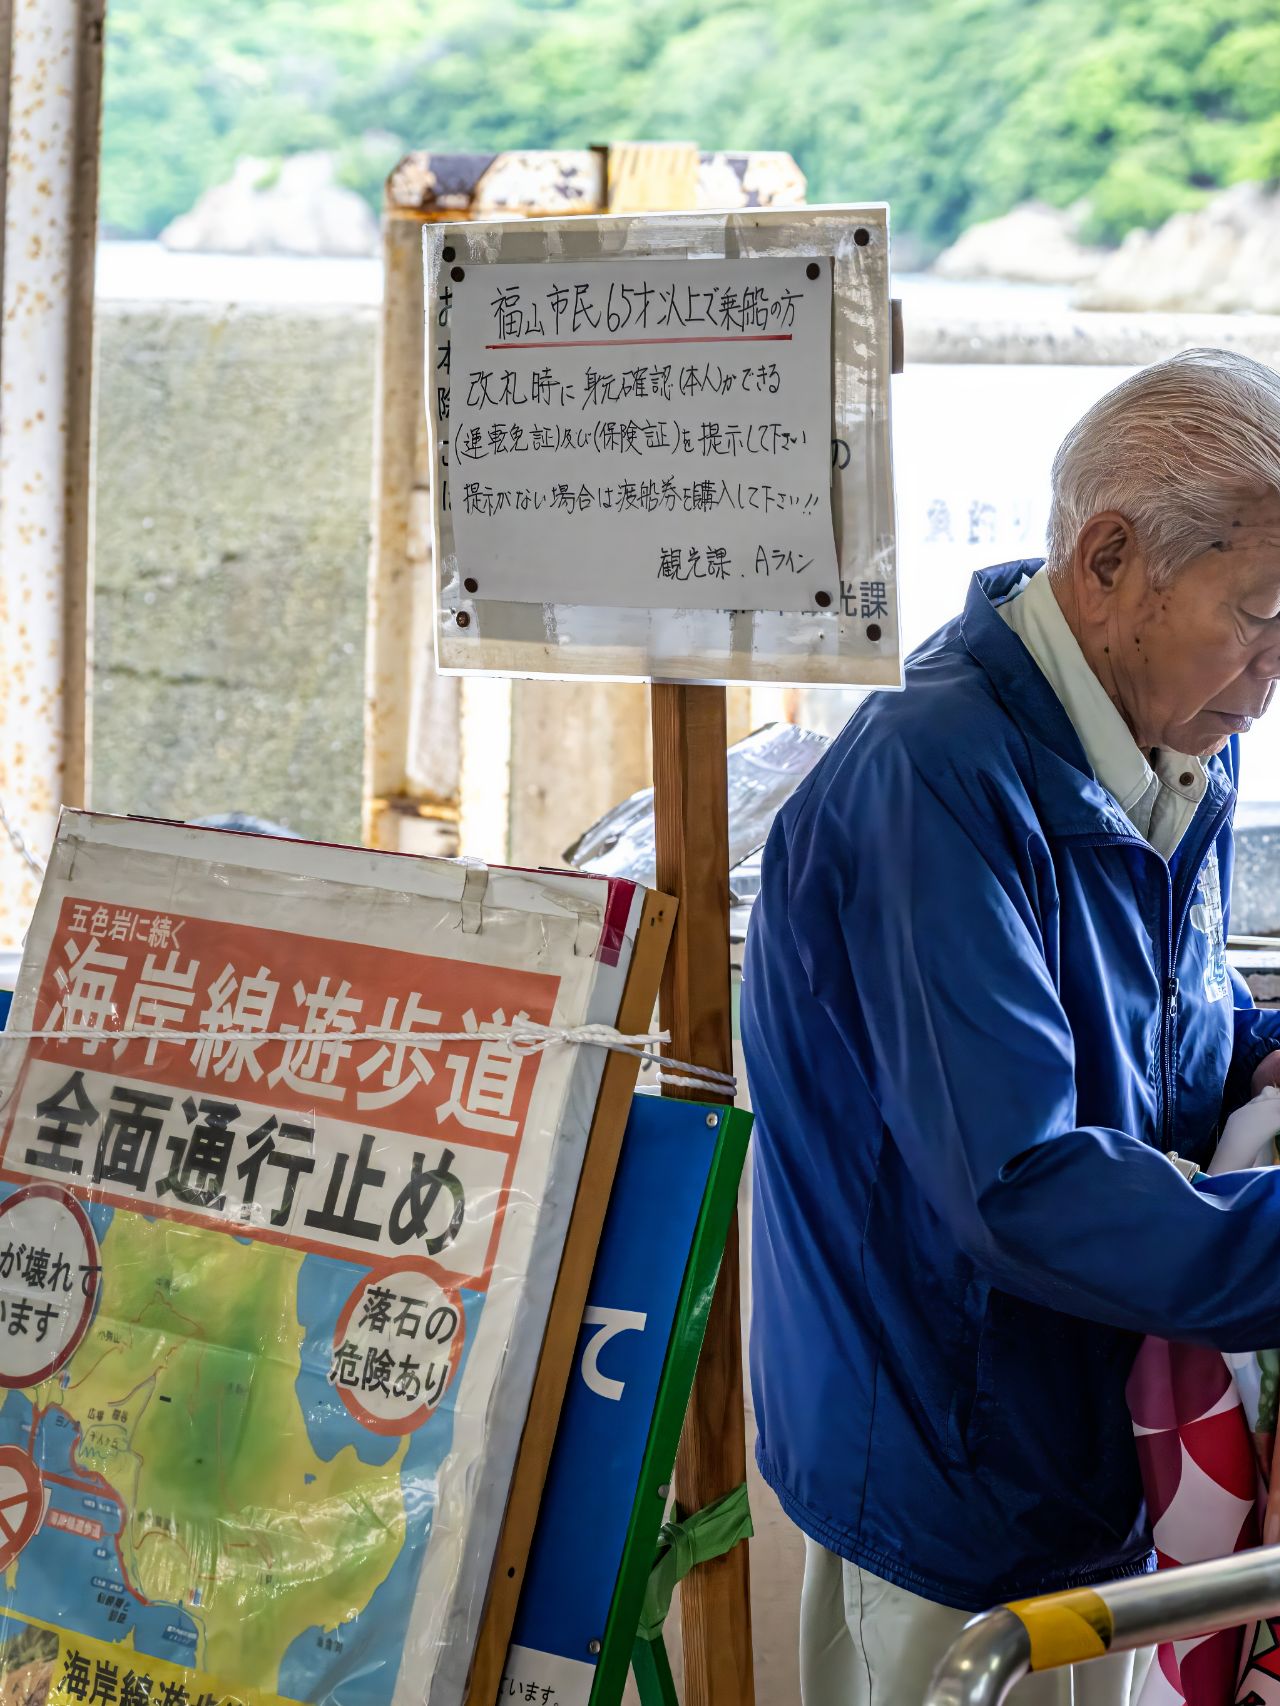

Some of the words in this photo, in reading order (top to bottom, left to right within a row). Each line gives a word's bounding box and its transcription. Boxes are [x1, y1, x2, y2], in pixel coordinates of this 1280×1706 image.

[67, 903, 186, 950] 五色岩に続く
[41, 937, 535, 1137] 海岸線遊歩道
[24, 1069, 466, 1256] 全面通行止め
[357, 1286, 459, 1345] 落石の
[329, 1339, 449, 1407] 危険あり
